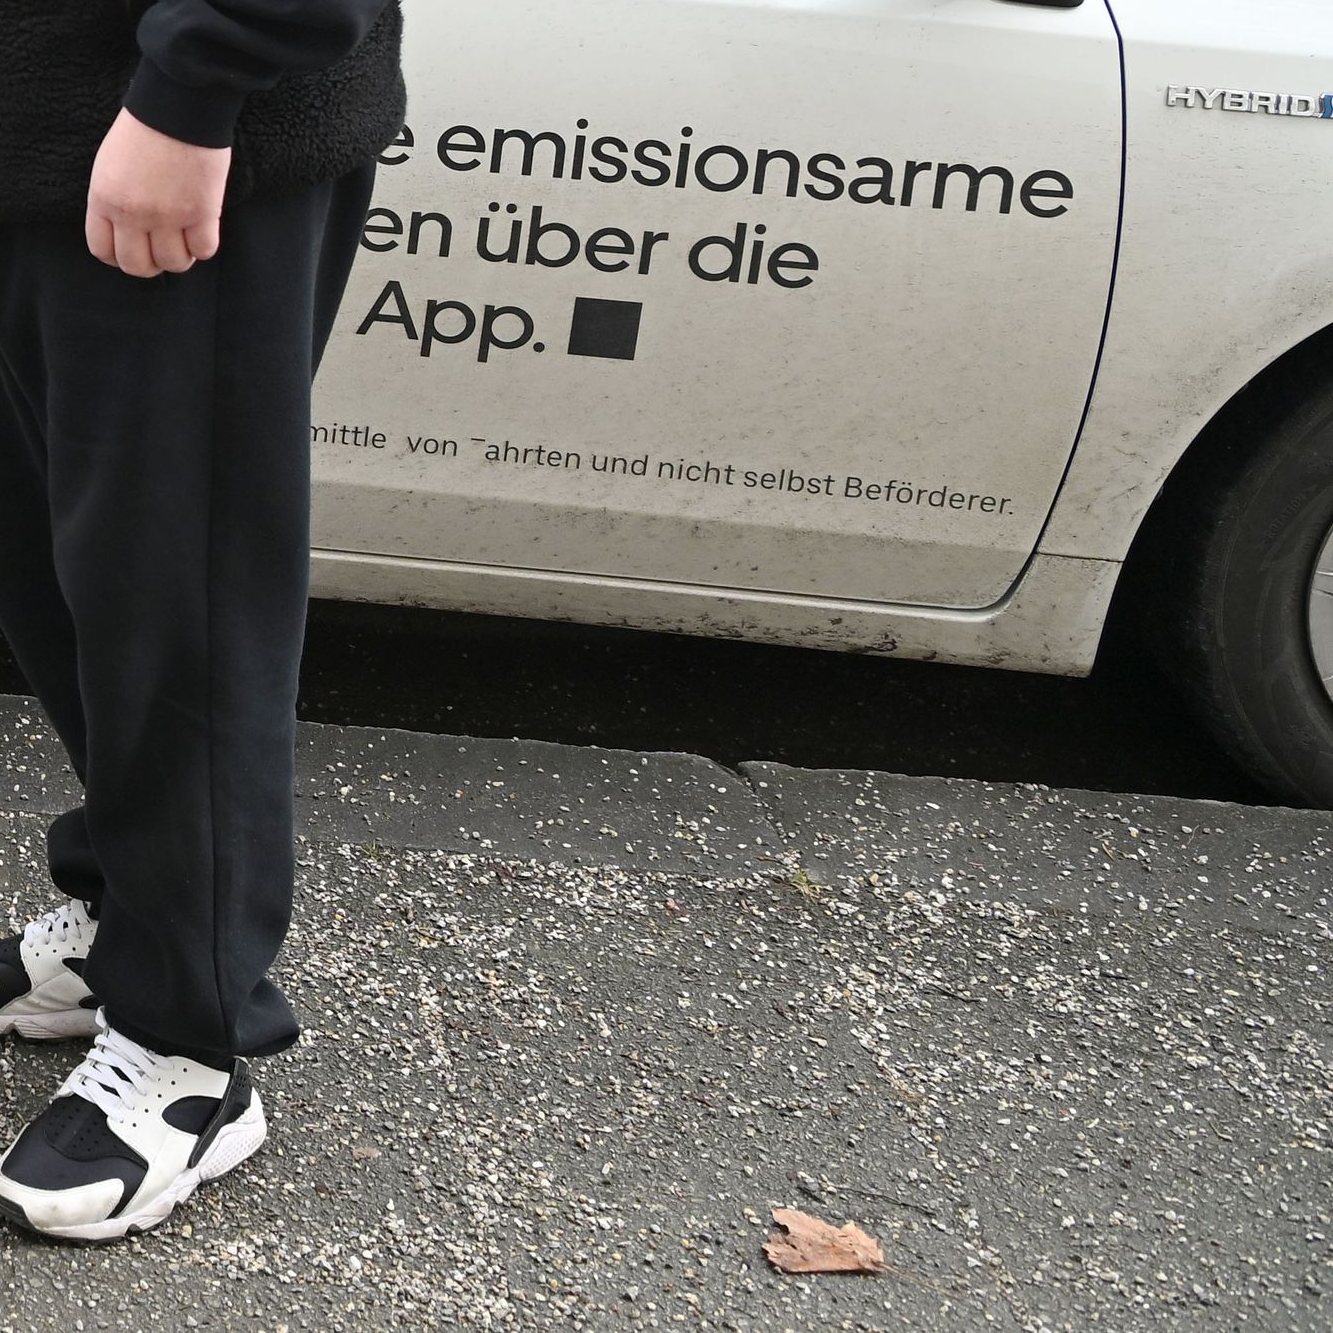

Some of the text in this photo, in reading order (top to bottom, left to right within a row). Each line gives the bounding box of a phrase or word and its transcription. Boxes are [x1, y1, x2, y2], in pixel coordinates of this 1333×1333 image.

[1167, 84, 1316, 117] HYBRID
[436, 118, 1074, 218] emissionsarme
[360, 201, 820, 289] en über die
[355, 279, 546, 364] App.
[310, 422, 1015, 516] mittle von ahrten und nicht selbst Beförderer.
